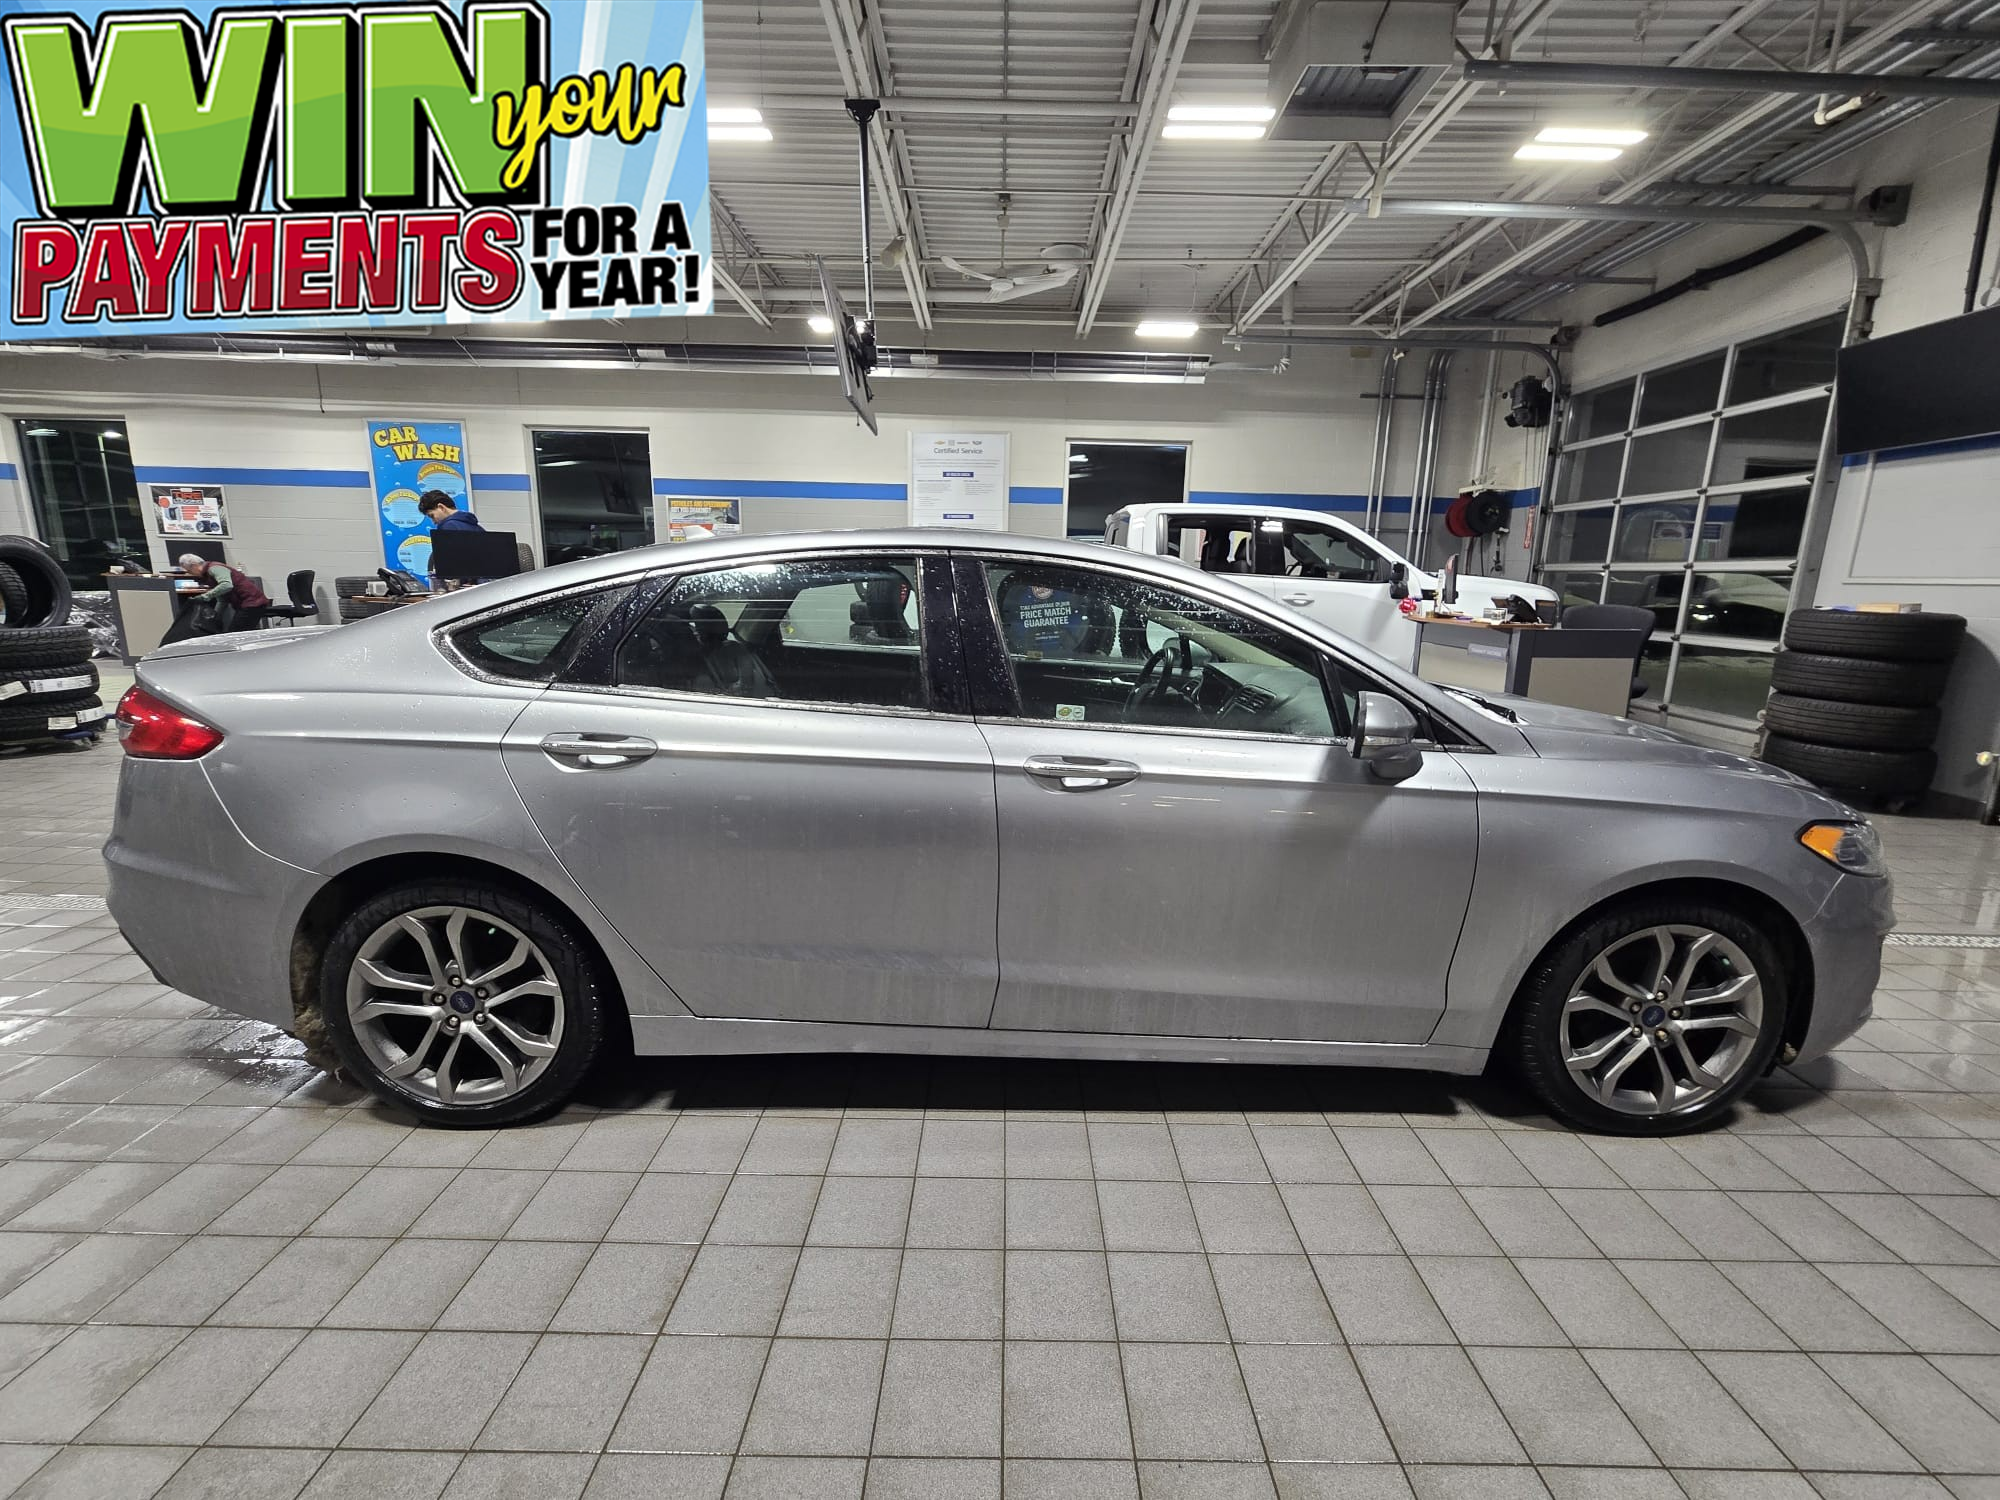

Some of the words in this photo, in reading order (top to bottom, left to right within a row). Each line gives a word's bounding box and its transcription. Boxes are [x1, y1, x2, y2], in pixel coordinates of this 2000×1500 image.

[374, 427, 419, 447] CAR
[393, 443, 460, 463] WASH
[1020, 610, 1043, 619] PRICE
[1044, 607, 1071, 617] MATCH
[1024, 616, 1069, 628] GUARANTEE
